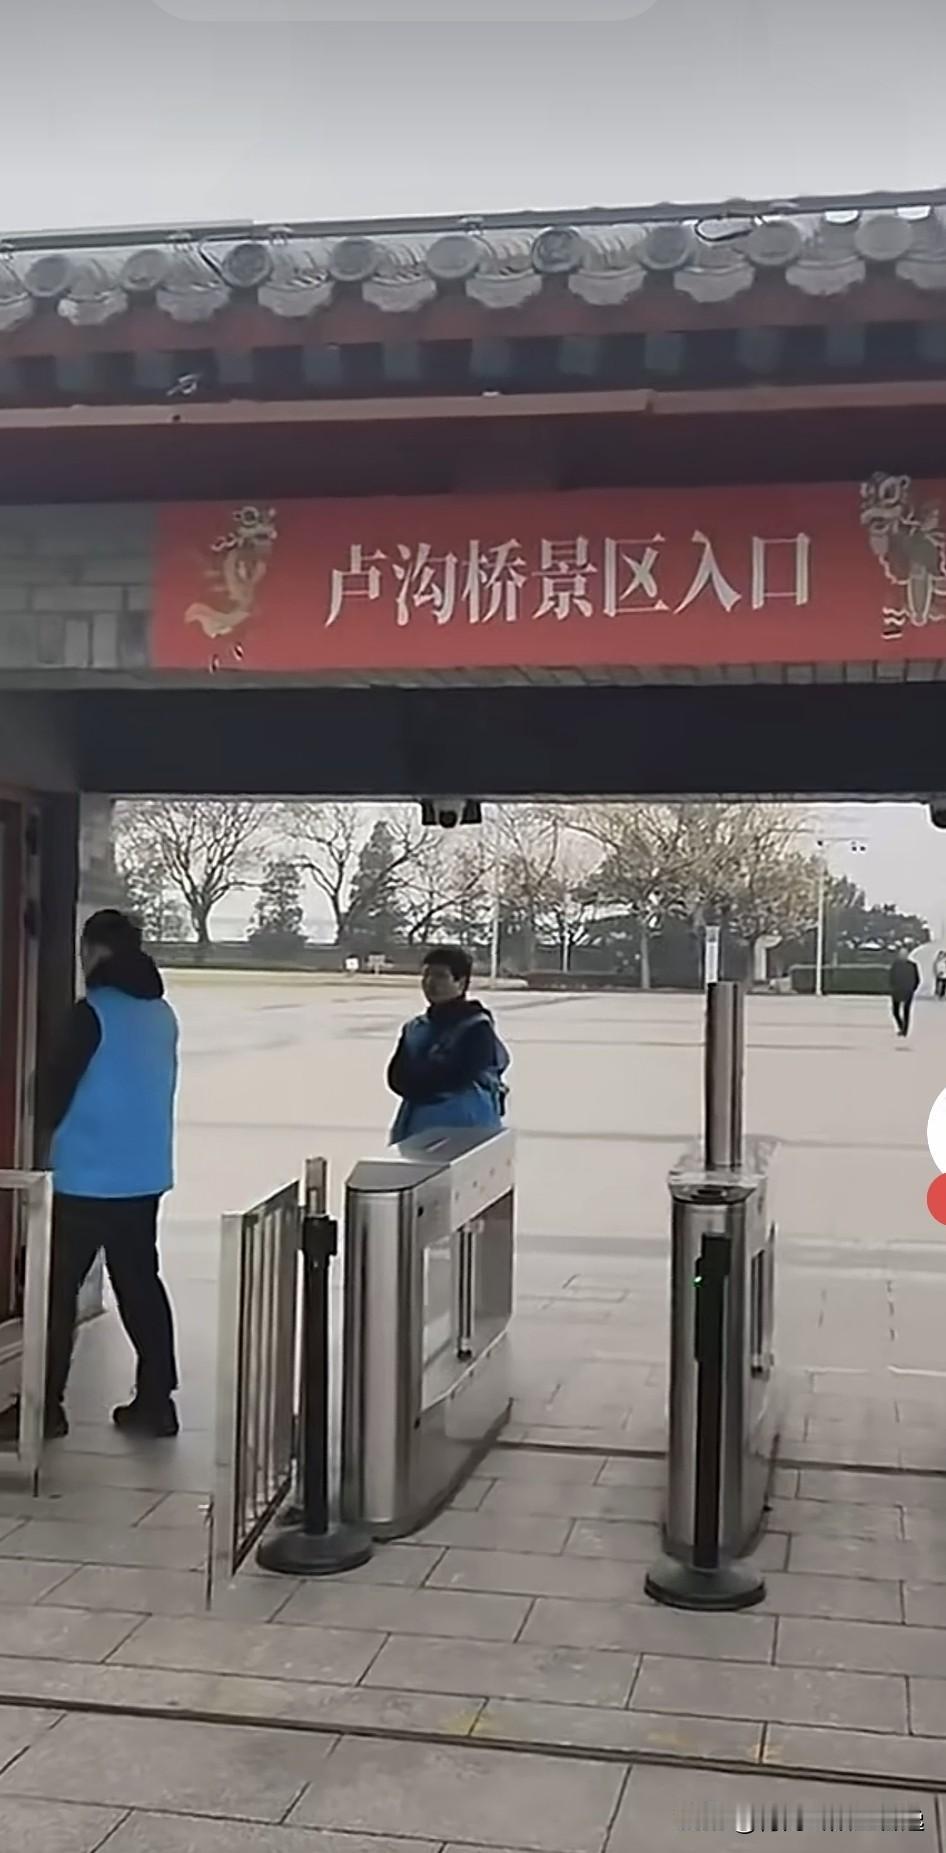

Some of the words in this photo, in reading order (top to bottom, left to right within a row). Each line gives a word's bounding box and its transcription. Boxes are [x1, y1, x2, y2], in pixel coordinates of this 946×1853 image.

[324, 530, 811, 628] 卢沟桥景区入口
